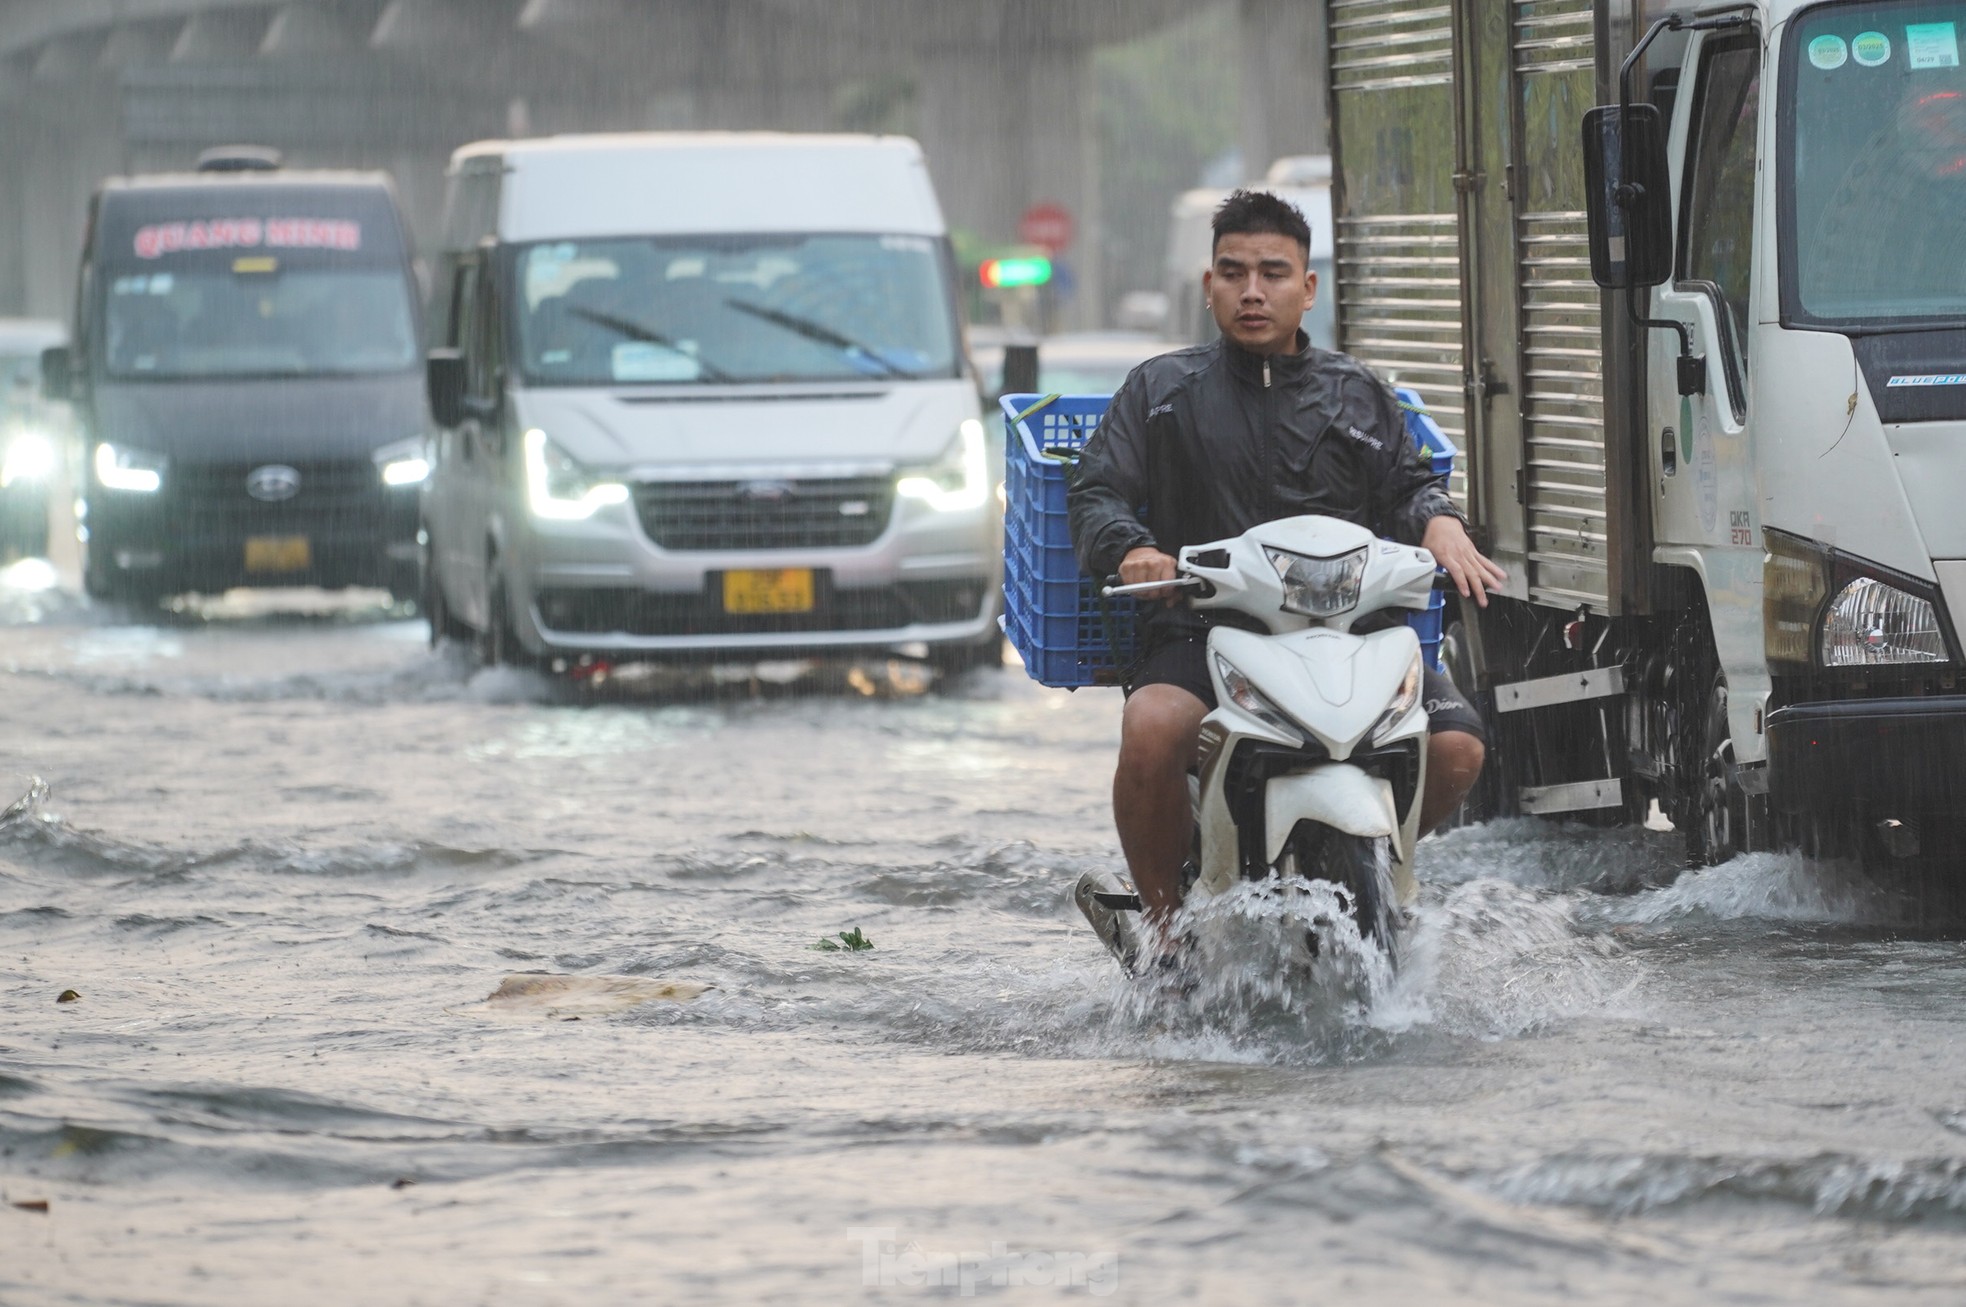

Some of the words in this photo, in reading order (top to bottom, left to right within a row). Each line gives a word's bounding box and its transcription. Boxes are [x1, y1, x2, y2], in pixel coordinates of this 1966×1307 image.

[134, 218, 262, 259] QUANG
[1730, 511, 1750, 527] QKR
[1731, 529, 1752, 545] 270
